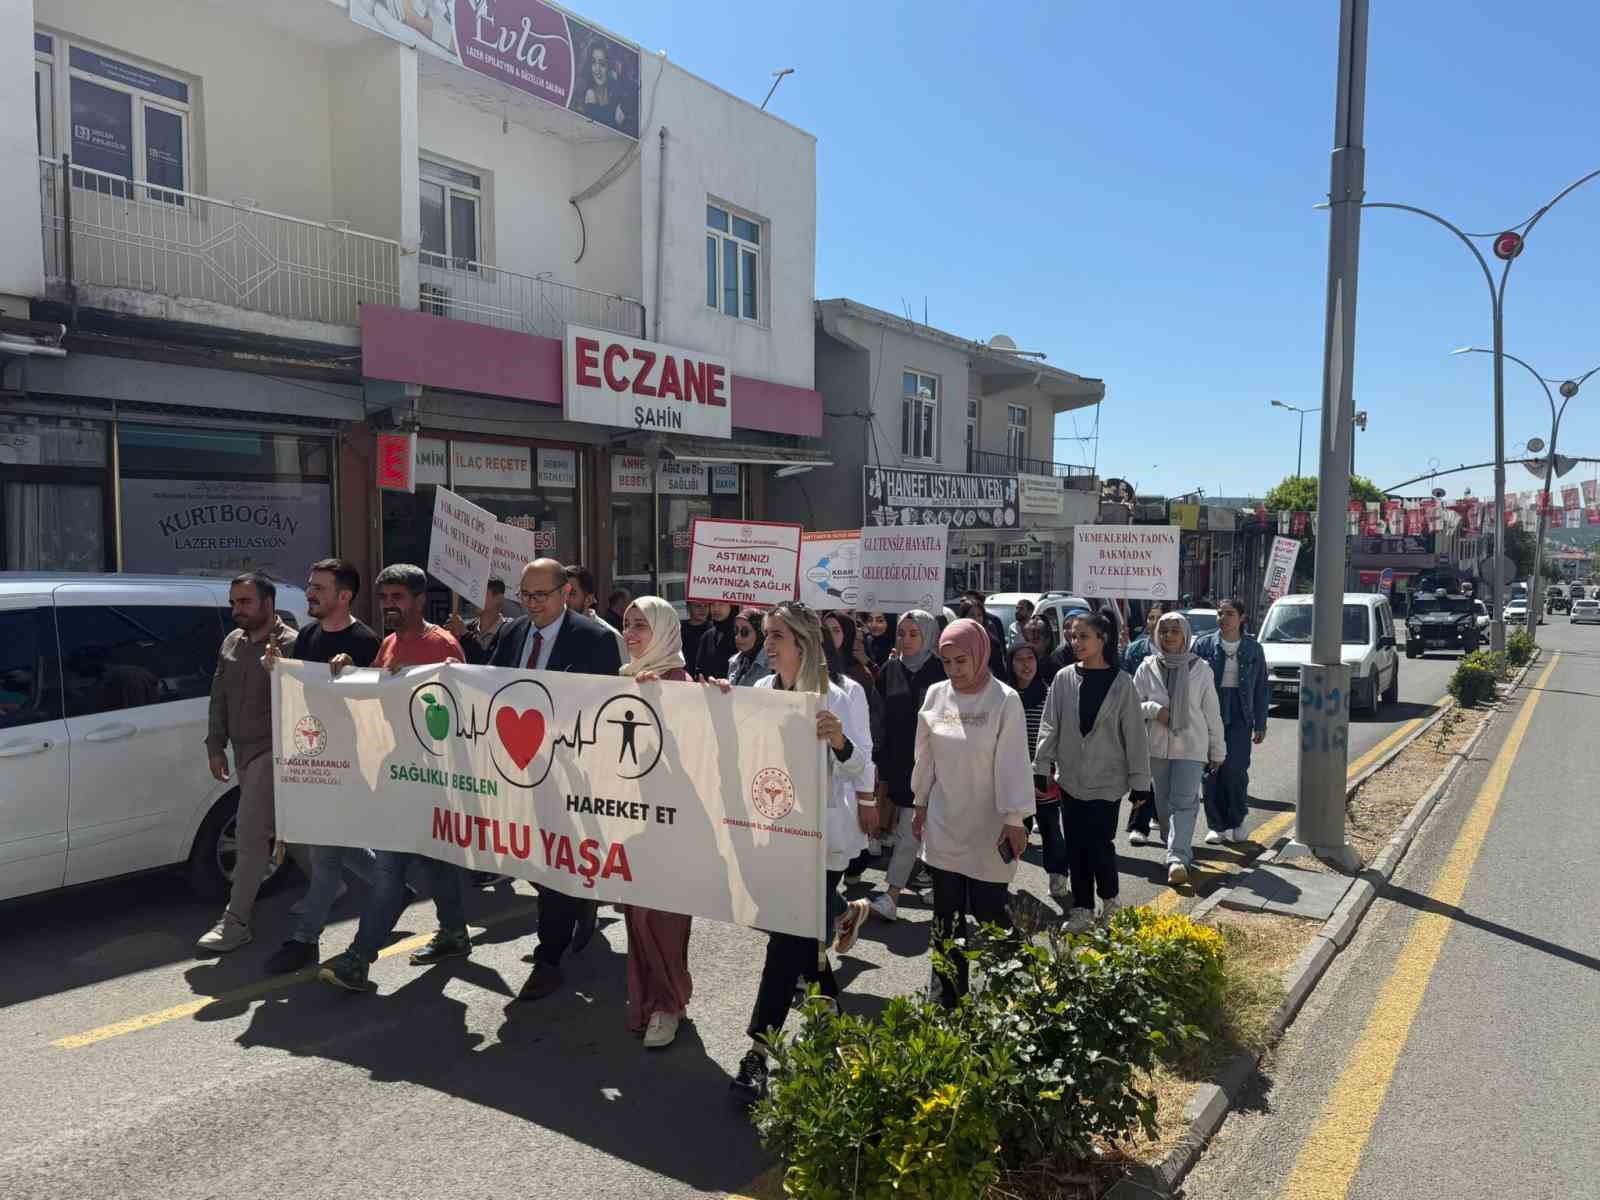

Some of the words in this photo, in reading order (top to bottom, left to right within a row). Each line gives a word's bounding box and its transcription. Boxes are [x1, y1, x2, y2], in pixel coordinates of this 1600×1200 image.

[575, 336, 727, 407] ECZANE
[634, 406, 682, 429] ŞAHİN
[456, 452, 483, 470] İLAÇ
[485, 457, 528, 473] REÇETE
[715, 479, 736, 490] BAKIM
[930, 475, 978, 498] USTA'NIN
[157, 504, 299, 537] KURTBOĞAN
[175, 537, 218, 550] LAZER
[220, 534, 288, 549] EPİLASYON
[864, 533, 905, 551] GLUTENSİZ
[906, 536, 942, 551] HAYATLA
[1079, 532, 1139, 544] YEMEKLERİN
[1140, 533, 1175, 544] TADINA
[716, 552, 770, 563] ASTIMINIZI
[1099, 549, 1153, 560] BAKMADAN
[862, 563, 899, 580] GELECEĞE
[901, 563, 940, 581] GÜLÜMSE
[1088, 565, 1106, 576] TUZ
[1107, 564, 1163, 576] EKLEMEYİN
[693, 575, 750, 588] HAYATINIZA
[752, 580, 792, 592] SAĞLIK
[722, 591, 756, 601] KATIN!
[310, 759, 351, 769] BAKANLIĞI
[389, 763, 449, 786] SAĞLIKLI
[451, 773, 499, 796] BESLEN
[566, 795, 650, 821] HAREKET
[656, 806, 677, 825] ET
[432, 806, 531, 859] MUTLU
[540, 827, 633, 889] YAŞA
